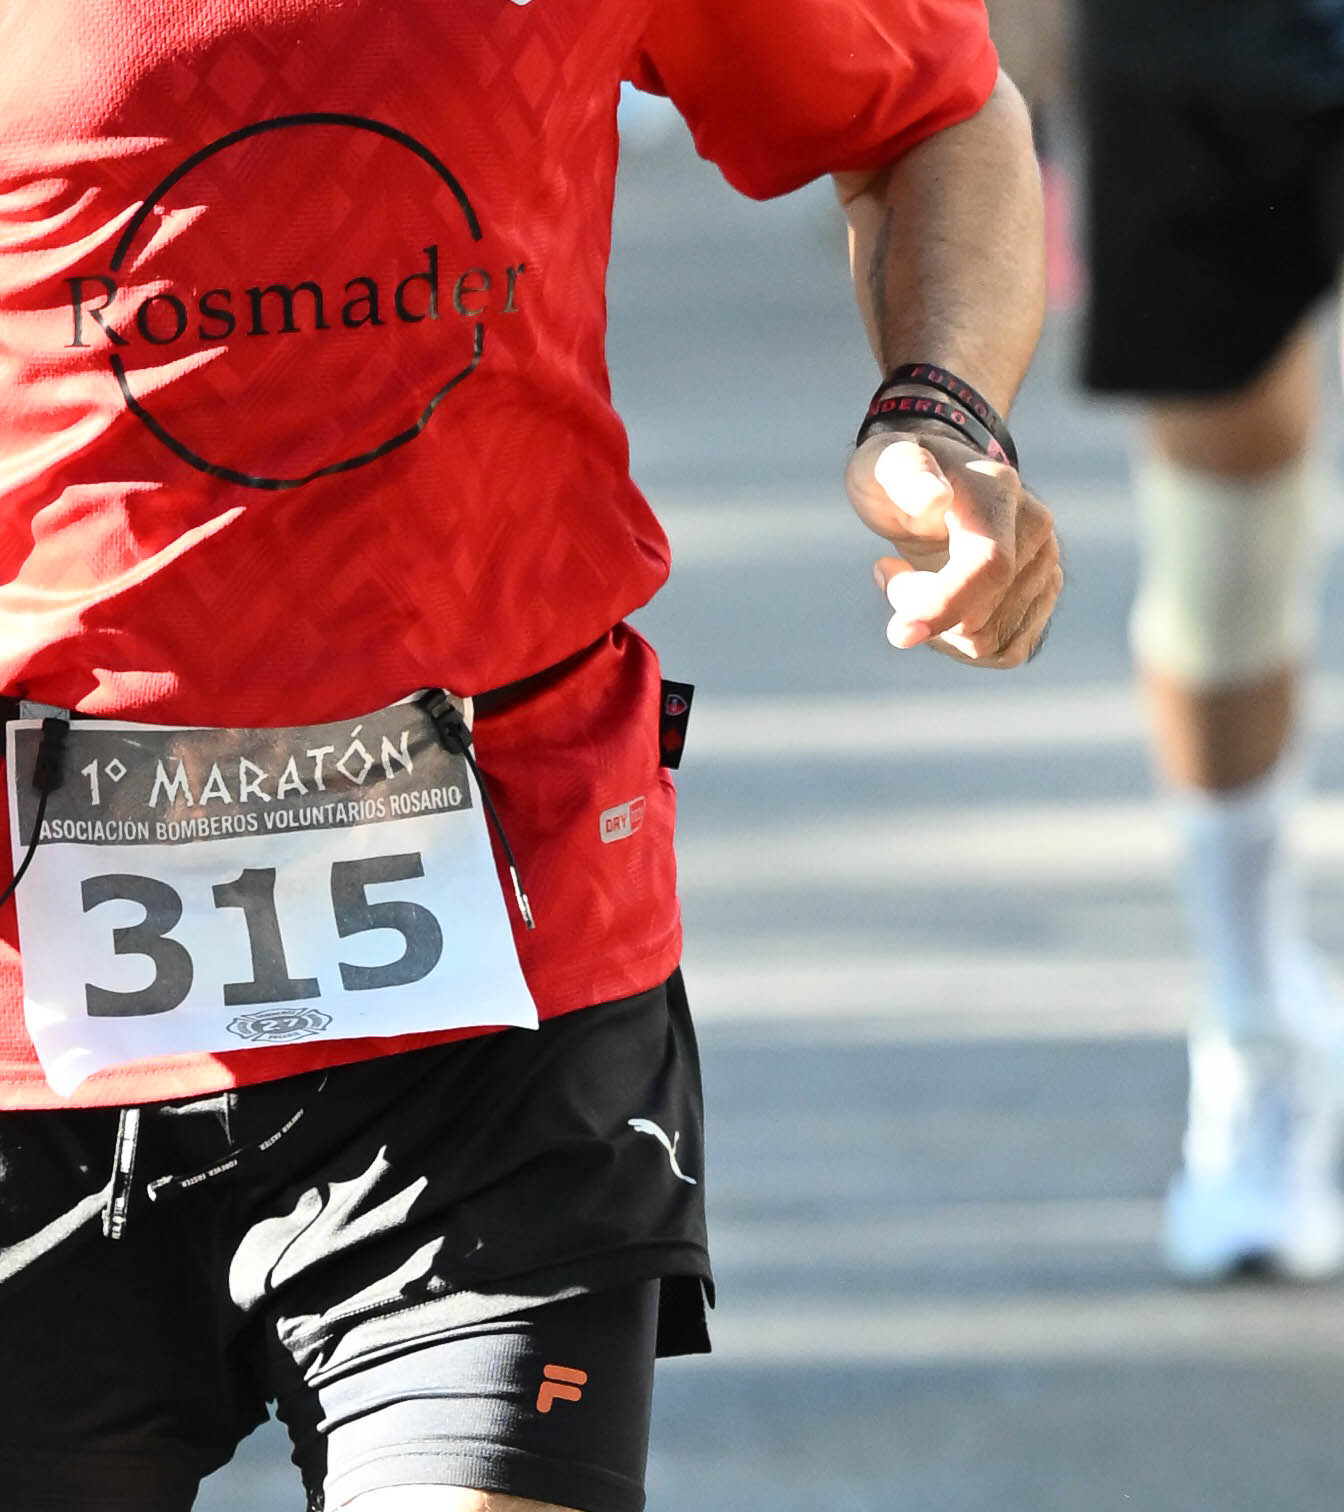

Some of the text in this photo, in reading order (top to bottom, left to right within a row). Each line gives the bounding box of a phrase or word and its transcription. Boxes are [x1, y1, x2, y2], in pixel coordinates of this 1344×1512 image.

[63, 245, 526, 349] Rosmader
[148, 724, 413, 808] MARATÓN
[39, 786, 463, 841] ASOCIACIÓN BOMBEROS VOLUNTARIOS ROSARIO
[80, 851, 443, 1017] 315
[260, 1018, 298, 1031] 27
